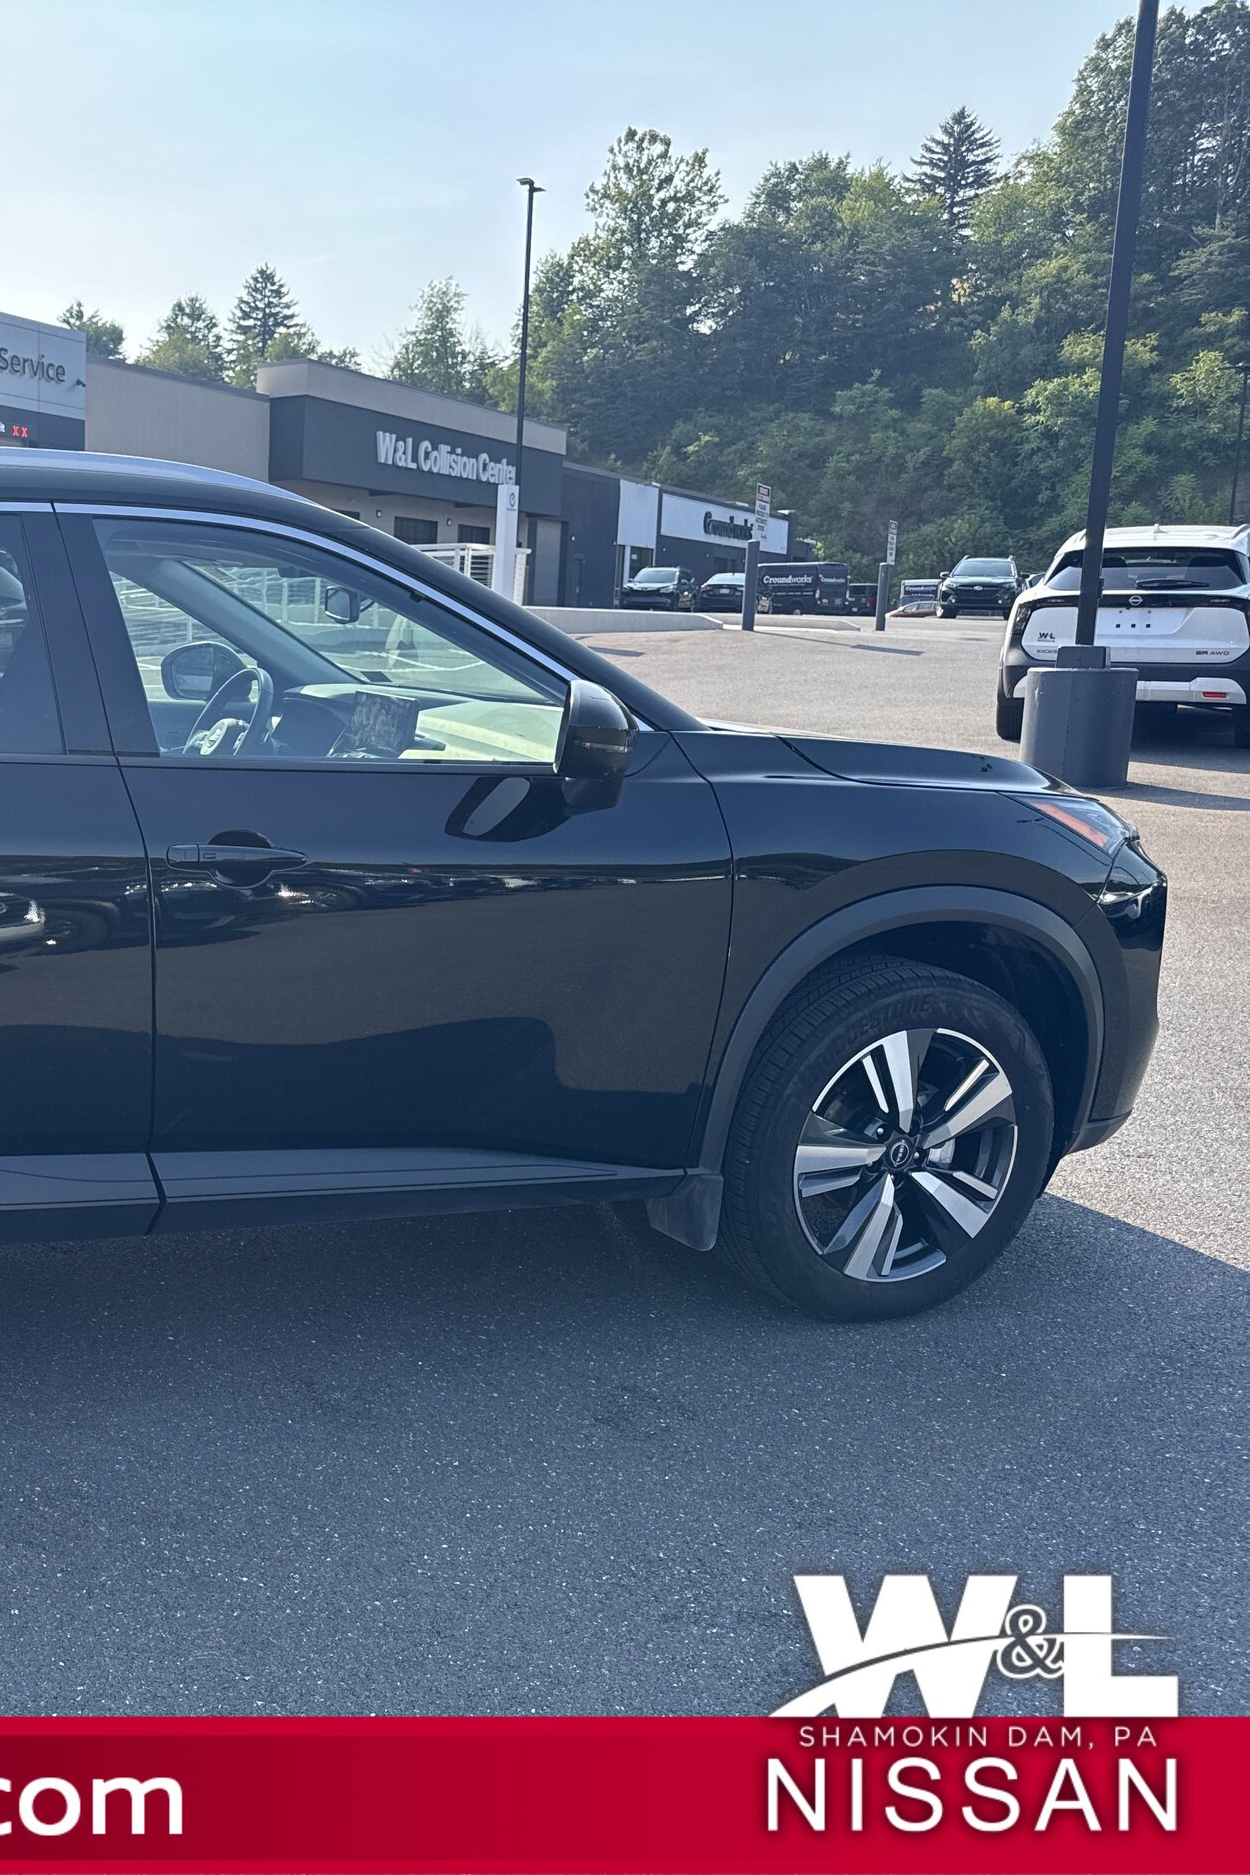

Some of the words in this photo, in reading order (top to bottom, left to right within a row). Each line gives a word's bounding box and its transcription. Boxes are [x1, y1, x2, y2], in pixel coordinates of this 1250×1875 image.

[376, 431, 417, 469] W&L
[418, 440, 477, 480] Collision
[763, 575, 812, 584] Groundworks
